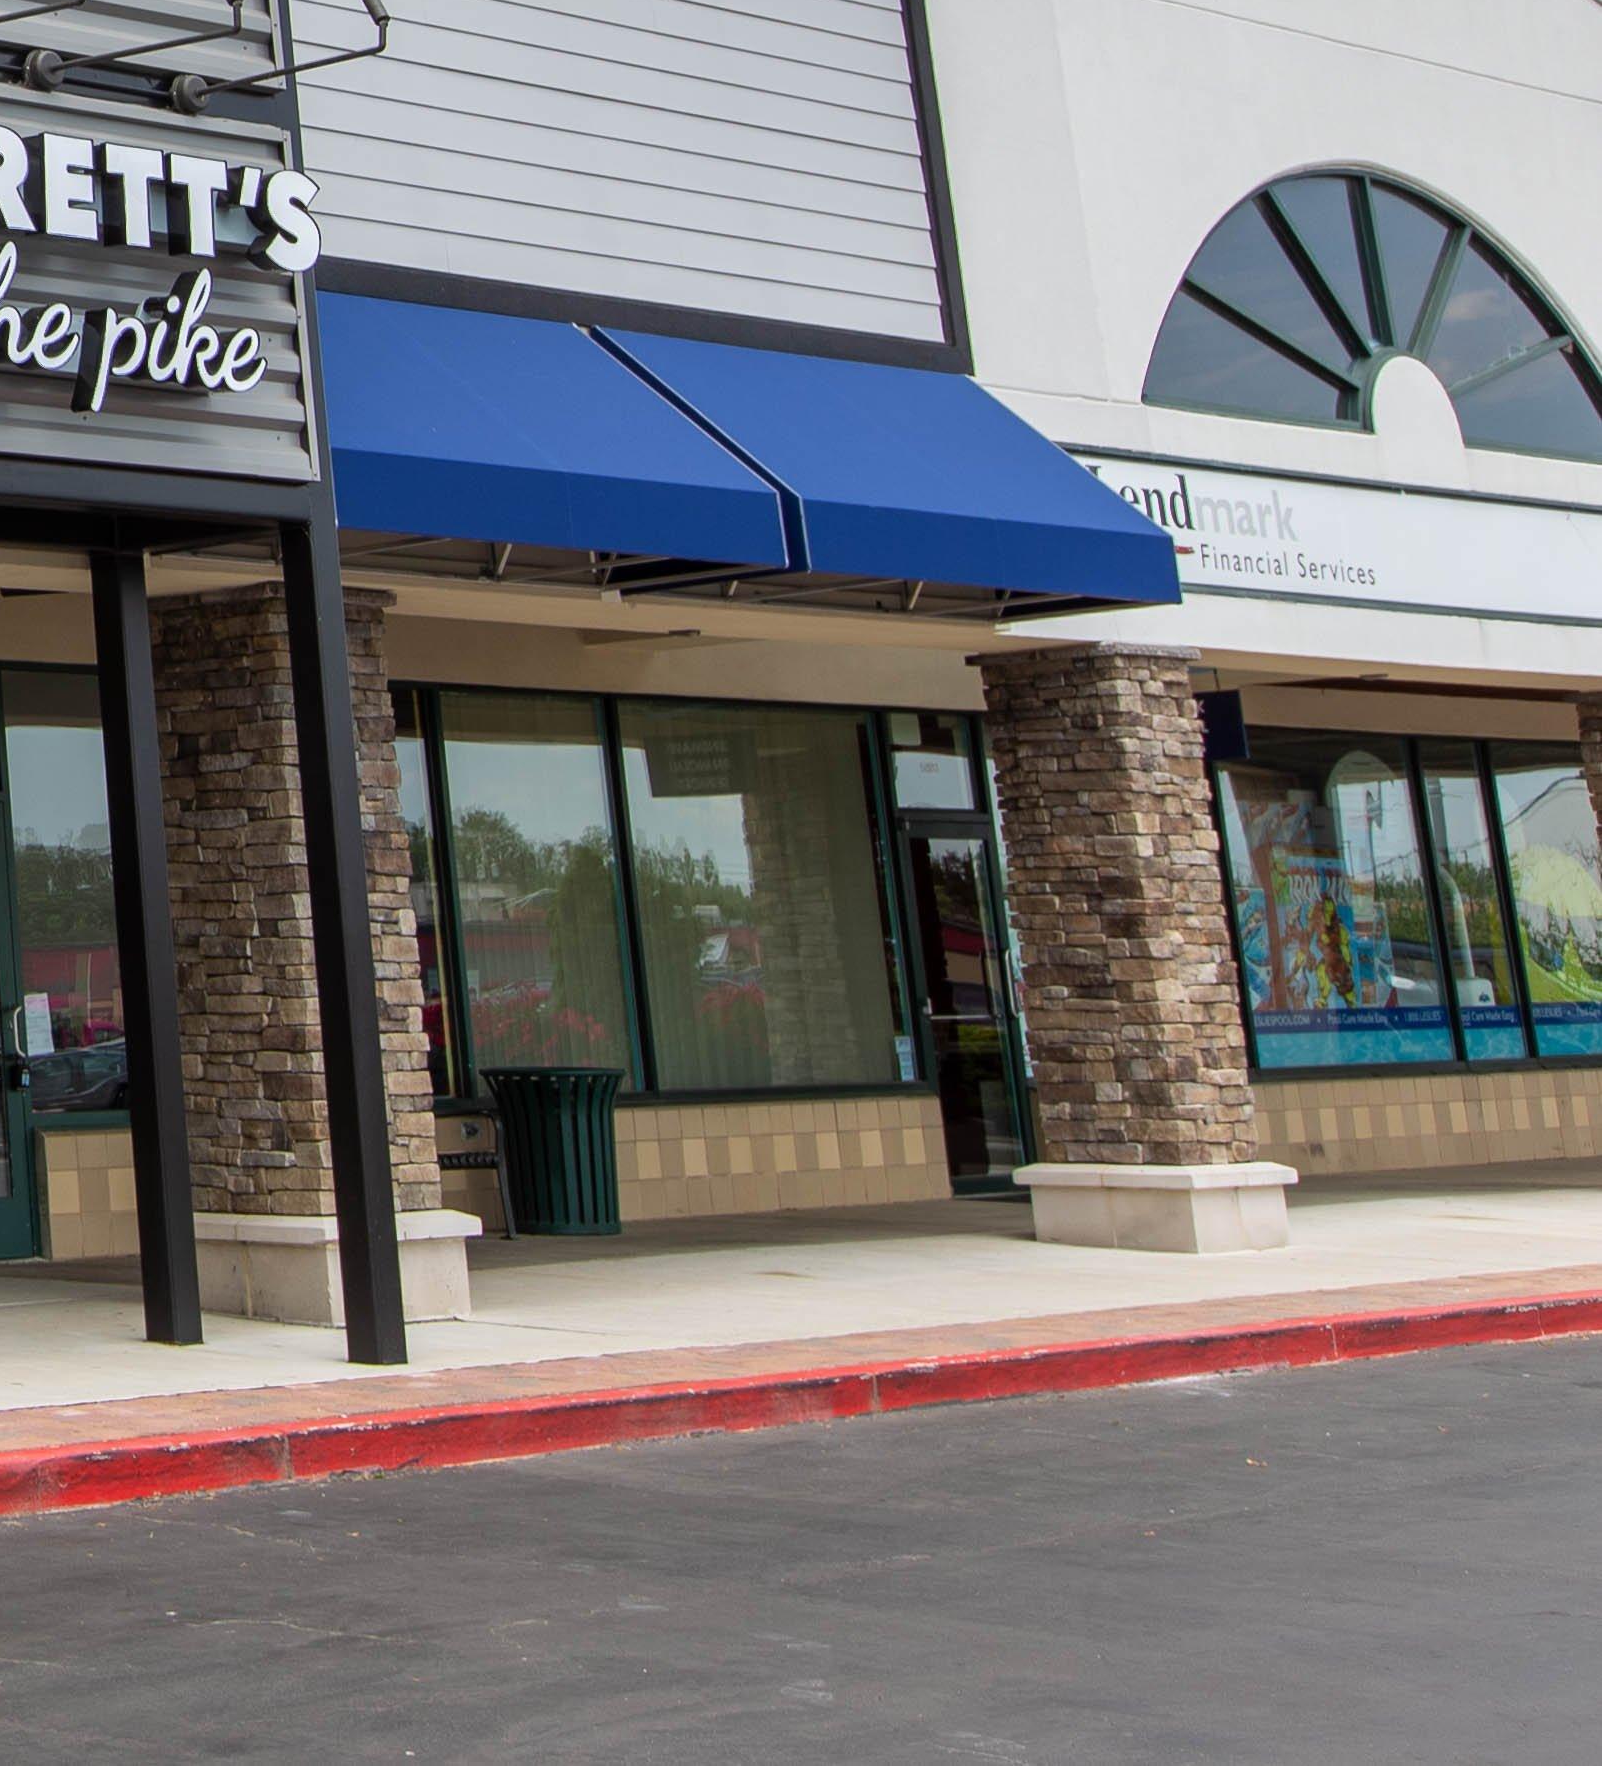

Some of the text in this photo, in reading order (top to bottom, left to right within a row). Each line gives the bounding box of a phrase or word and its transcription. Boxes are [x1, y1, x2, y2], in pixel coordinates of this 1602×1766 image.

[88, 267, 269, 413] pike
[1200, 543, 1377, 586] Financial Services
